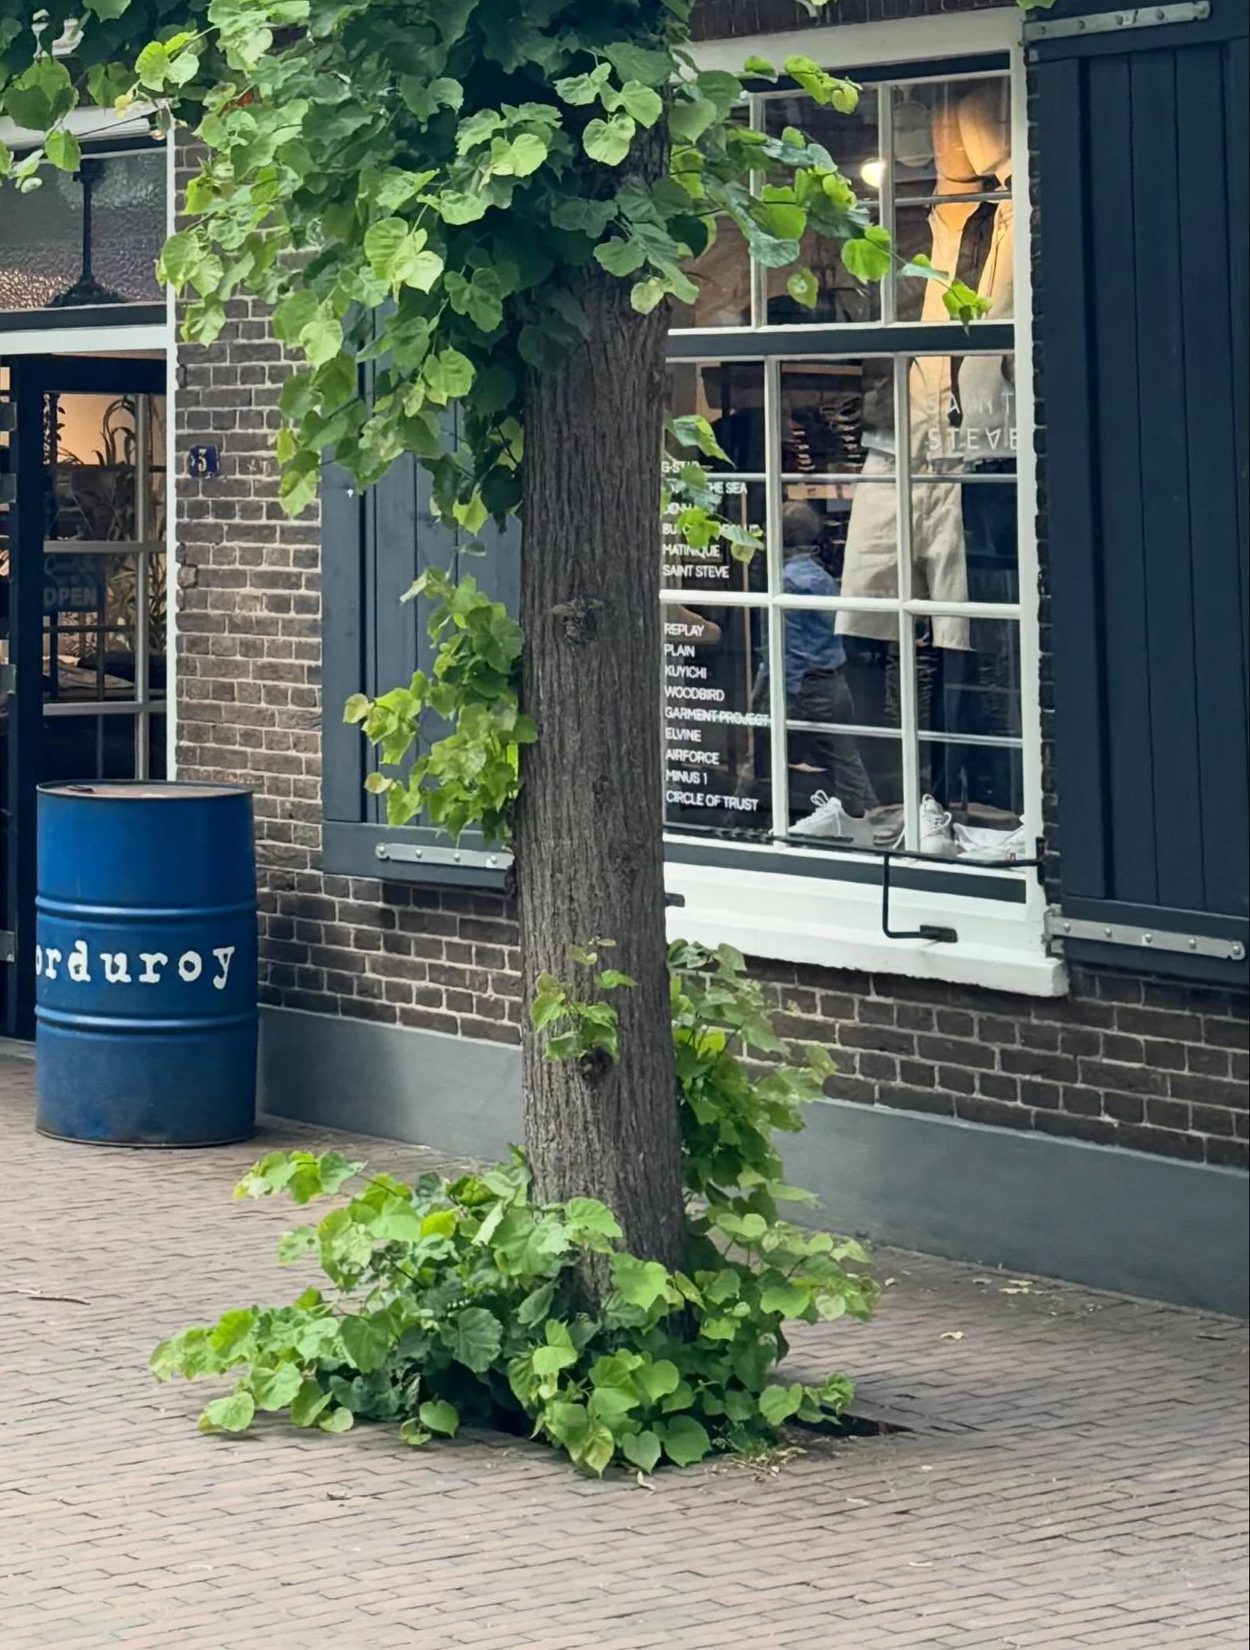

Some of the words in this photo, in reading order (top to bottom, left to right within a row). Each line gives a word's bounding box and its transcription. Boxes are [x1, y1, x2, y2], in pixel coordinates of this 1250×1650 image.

[725, 482, 748, 494] SEA
[662, 543, 720, 559] MATINQUE
[662, 564, 693, 577] SAINT
[695, 565, 729, 578] STEVE
[43, 587, 97, 607] OPEN
[664, 623, 705, 637] REPLAY
[664, 644, 695, 658] PLAIN
[665, 665, 707, 679] KUYICHI
[664, 686, 725, 702] WOODBIRD
[665, 707, 717, 722] GARMENT
[719, 711, 770, 726] PROJECT
[665, 727, 702, 742] ELVINE
[665, 749, 720, 765] AIRFORCE
[666, 770, 700, 784] MINUS
[666, 790, 704, 806] CIRCLE
[705, 794, 721, 807] OF
[721, 796, 759, 811] TRUST
